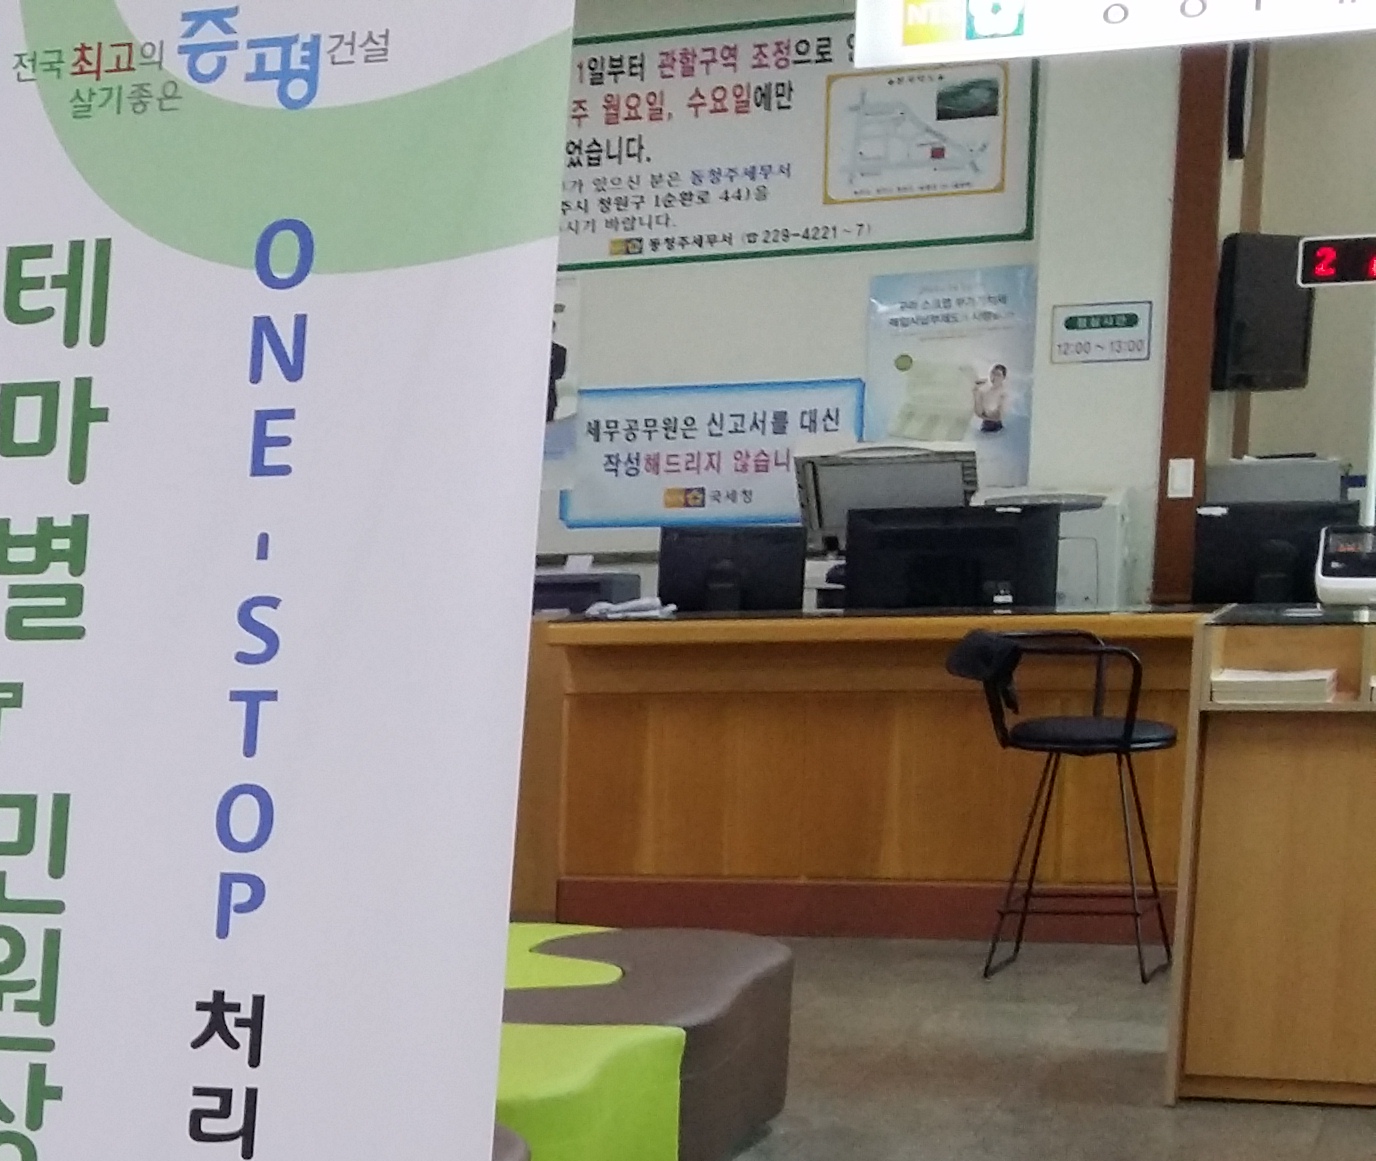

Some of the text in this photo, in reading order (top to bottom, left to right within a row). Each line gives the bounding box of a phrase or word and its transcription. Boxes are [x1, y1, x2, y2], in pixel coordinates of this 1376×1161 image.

[11, 4, 390, 111] 전국 최고의 증평 건설
[657, 42, 739, 80] 관할구역
[751, 35, 834, 71] 조정으로
[686, 80, 794, 118] 수요일에만
[1314, 245, 1337, 276] 2
[585, 407, 841, 442] 세무공무원은 신고서를 대신
[603, 449, 723, 477] 작성해드리지
